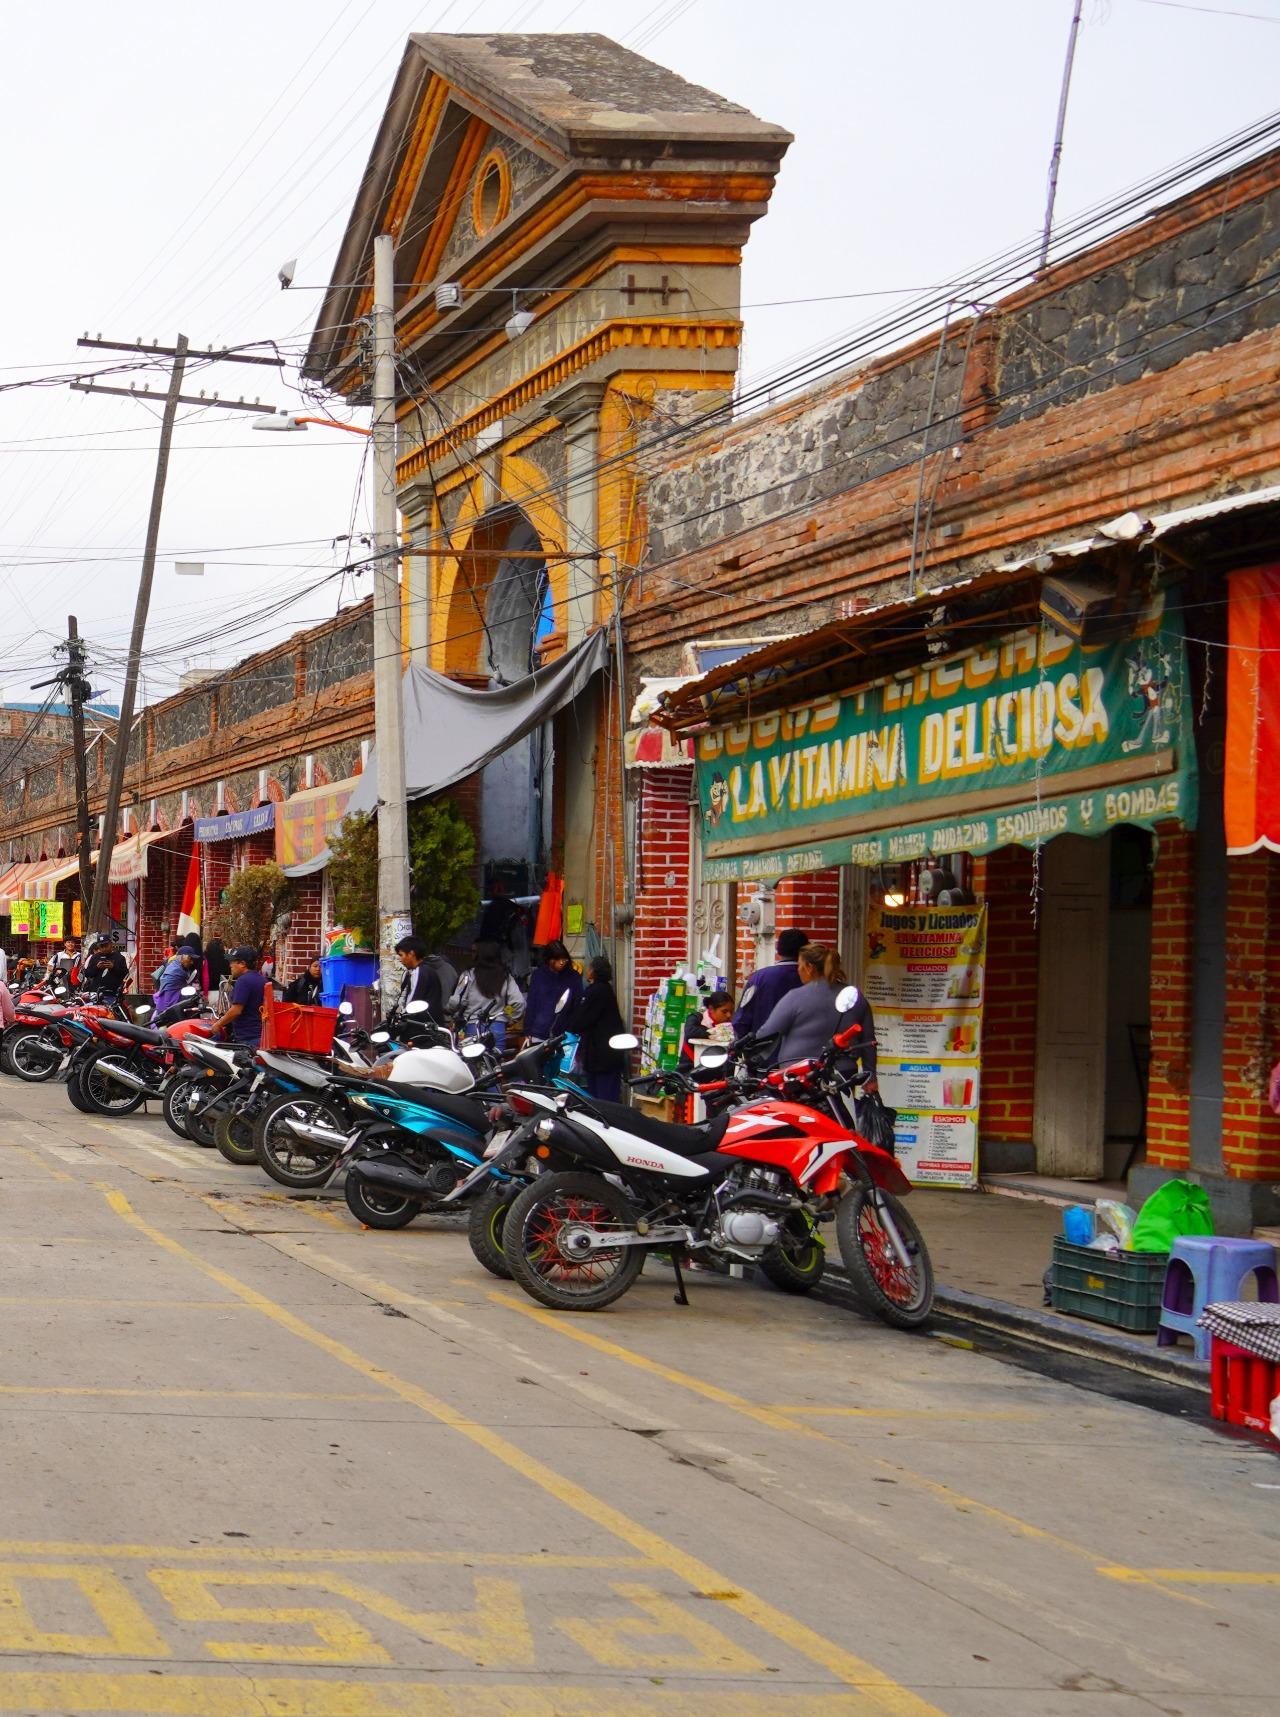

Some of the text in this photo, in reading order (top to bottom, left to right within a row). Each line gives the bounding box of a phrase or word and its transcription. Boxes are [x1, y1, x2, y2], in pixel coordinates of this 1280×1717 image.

[730, 667, 1110, 823] LA VITAMINA DELICIOSA
[996, 805, 1068, 842] ESQUIMOS
[1104, 781, 1181, 821] BOMBAS
[880, 911, 979, 932] Jugos y Licuados
[901, 946, 958, 958] DELICIOSA
[911, 964, 947, 972] LICUADOS
[934, 1115, 965, 1123] ESKIMOS
[626, 1155, 666, 1171] HONDA
